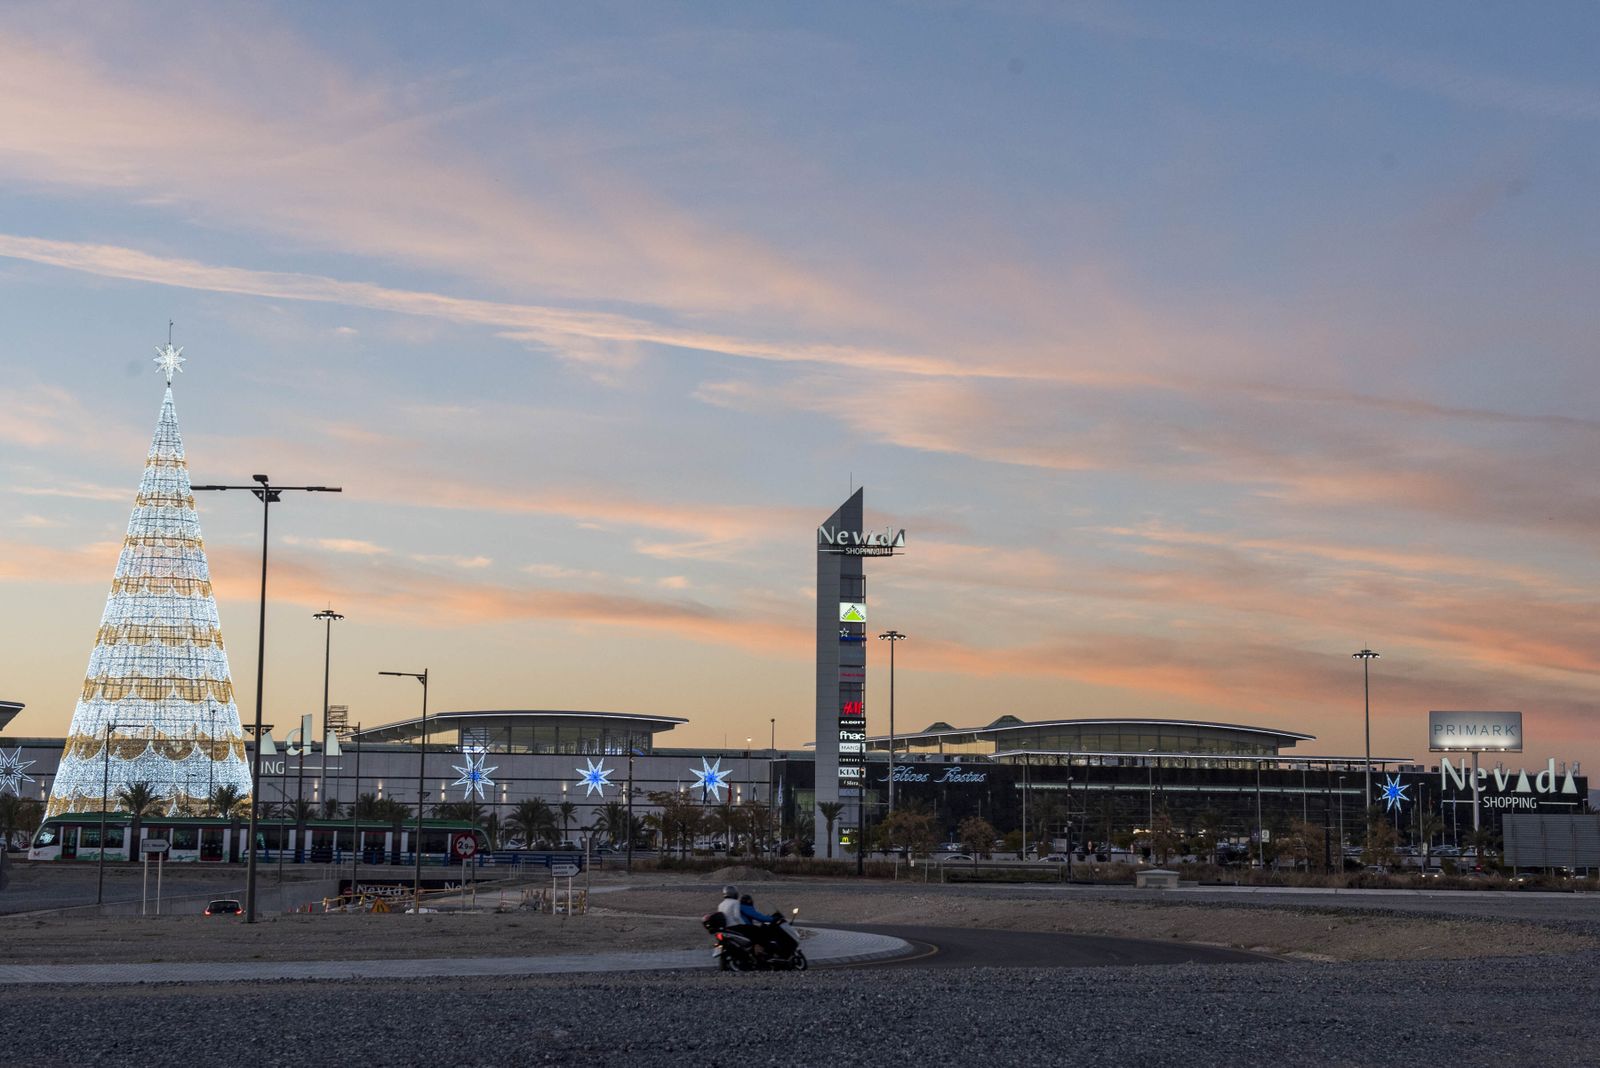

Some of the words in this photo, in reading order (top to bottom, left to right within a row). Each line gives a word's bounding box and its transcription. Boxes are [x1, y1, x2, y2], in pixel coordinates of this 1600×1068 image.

[840, 730, 865, 740] fnac
[1433, 724, 1515, 736] PRIMARK
[933, 766, 987, 782] Fiestas
[1483, 796, 1537, 809] SHOPPING
